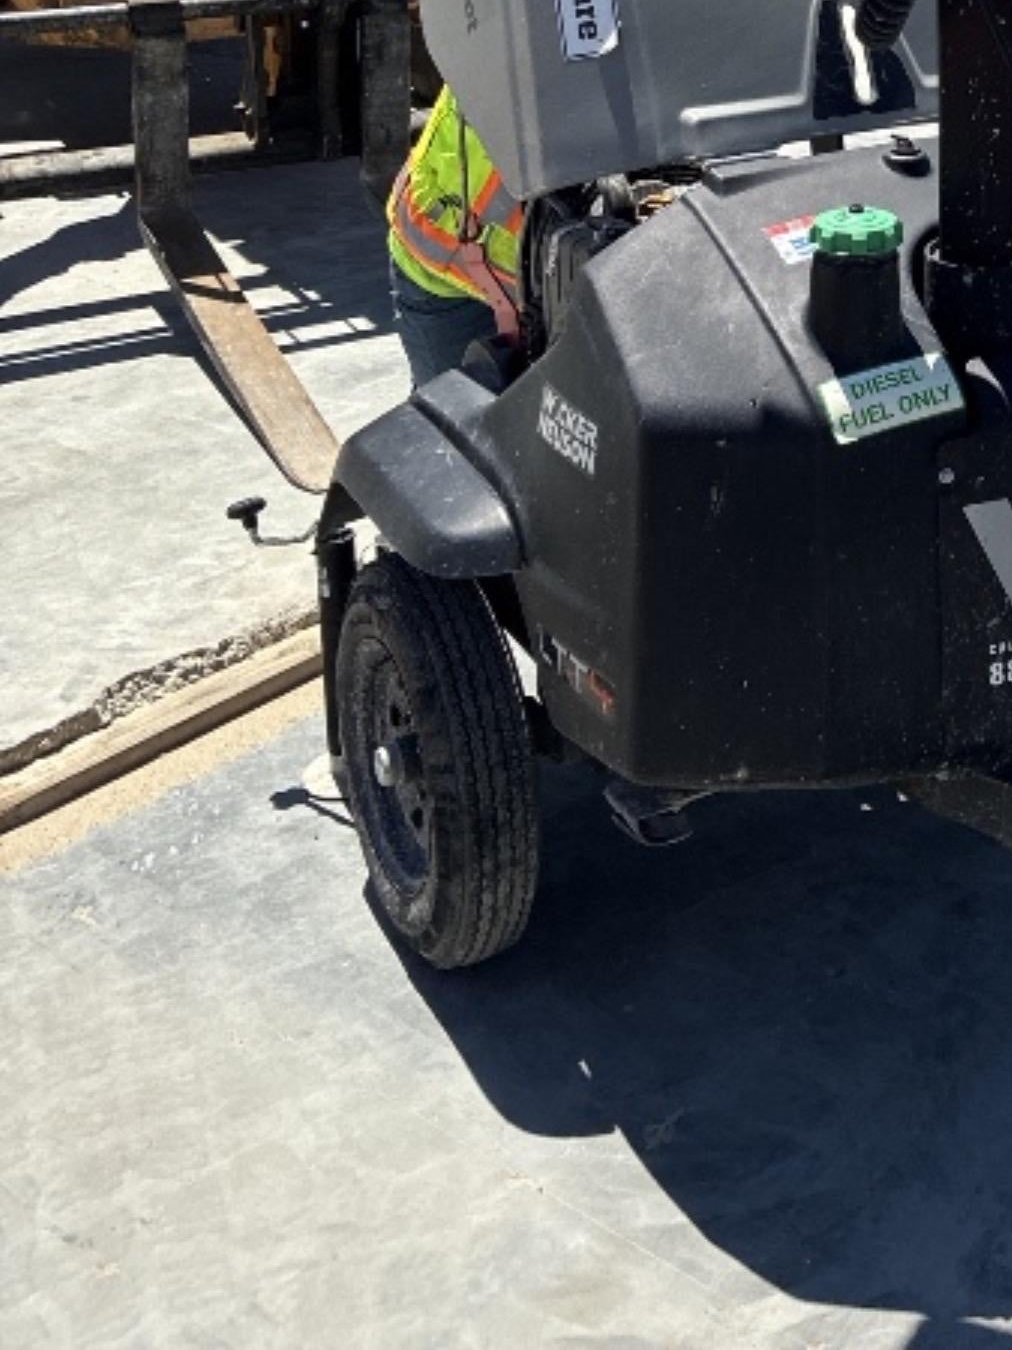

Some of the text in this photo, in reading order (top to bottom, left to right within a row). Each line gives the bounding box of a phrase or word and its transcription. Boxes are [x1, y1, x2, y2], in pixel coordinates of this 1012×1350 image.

[850, 365, 924, 400] DIESEL
[839, 383, 950, 433] FUEL ONLY
